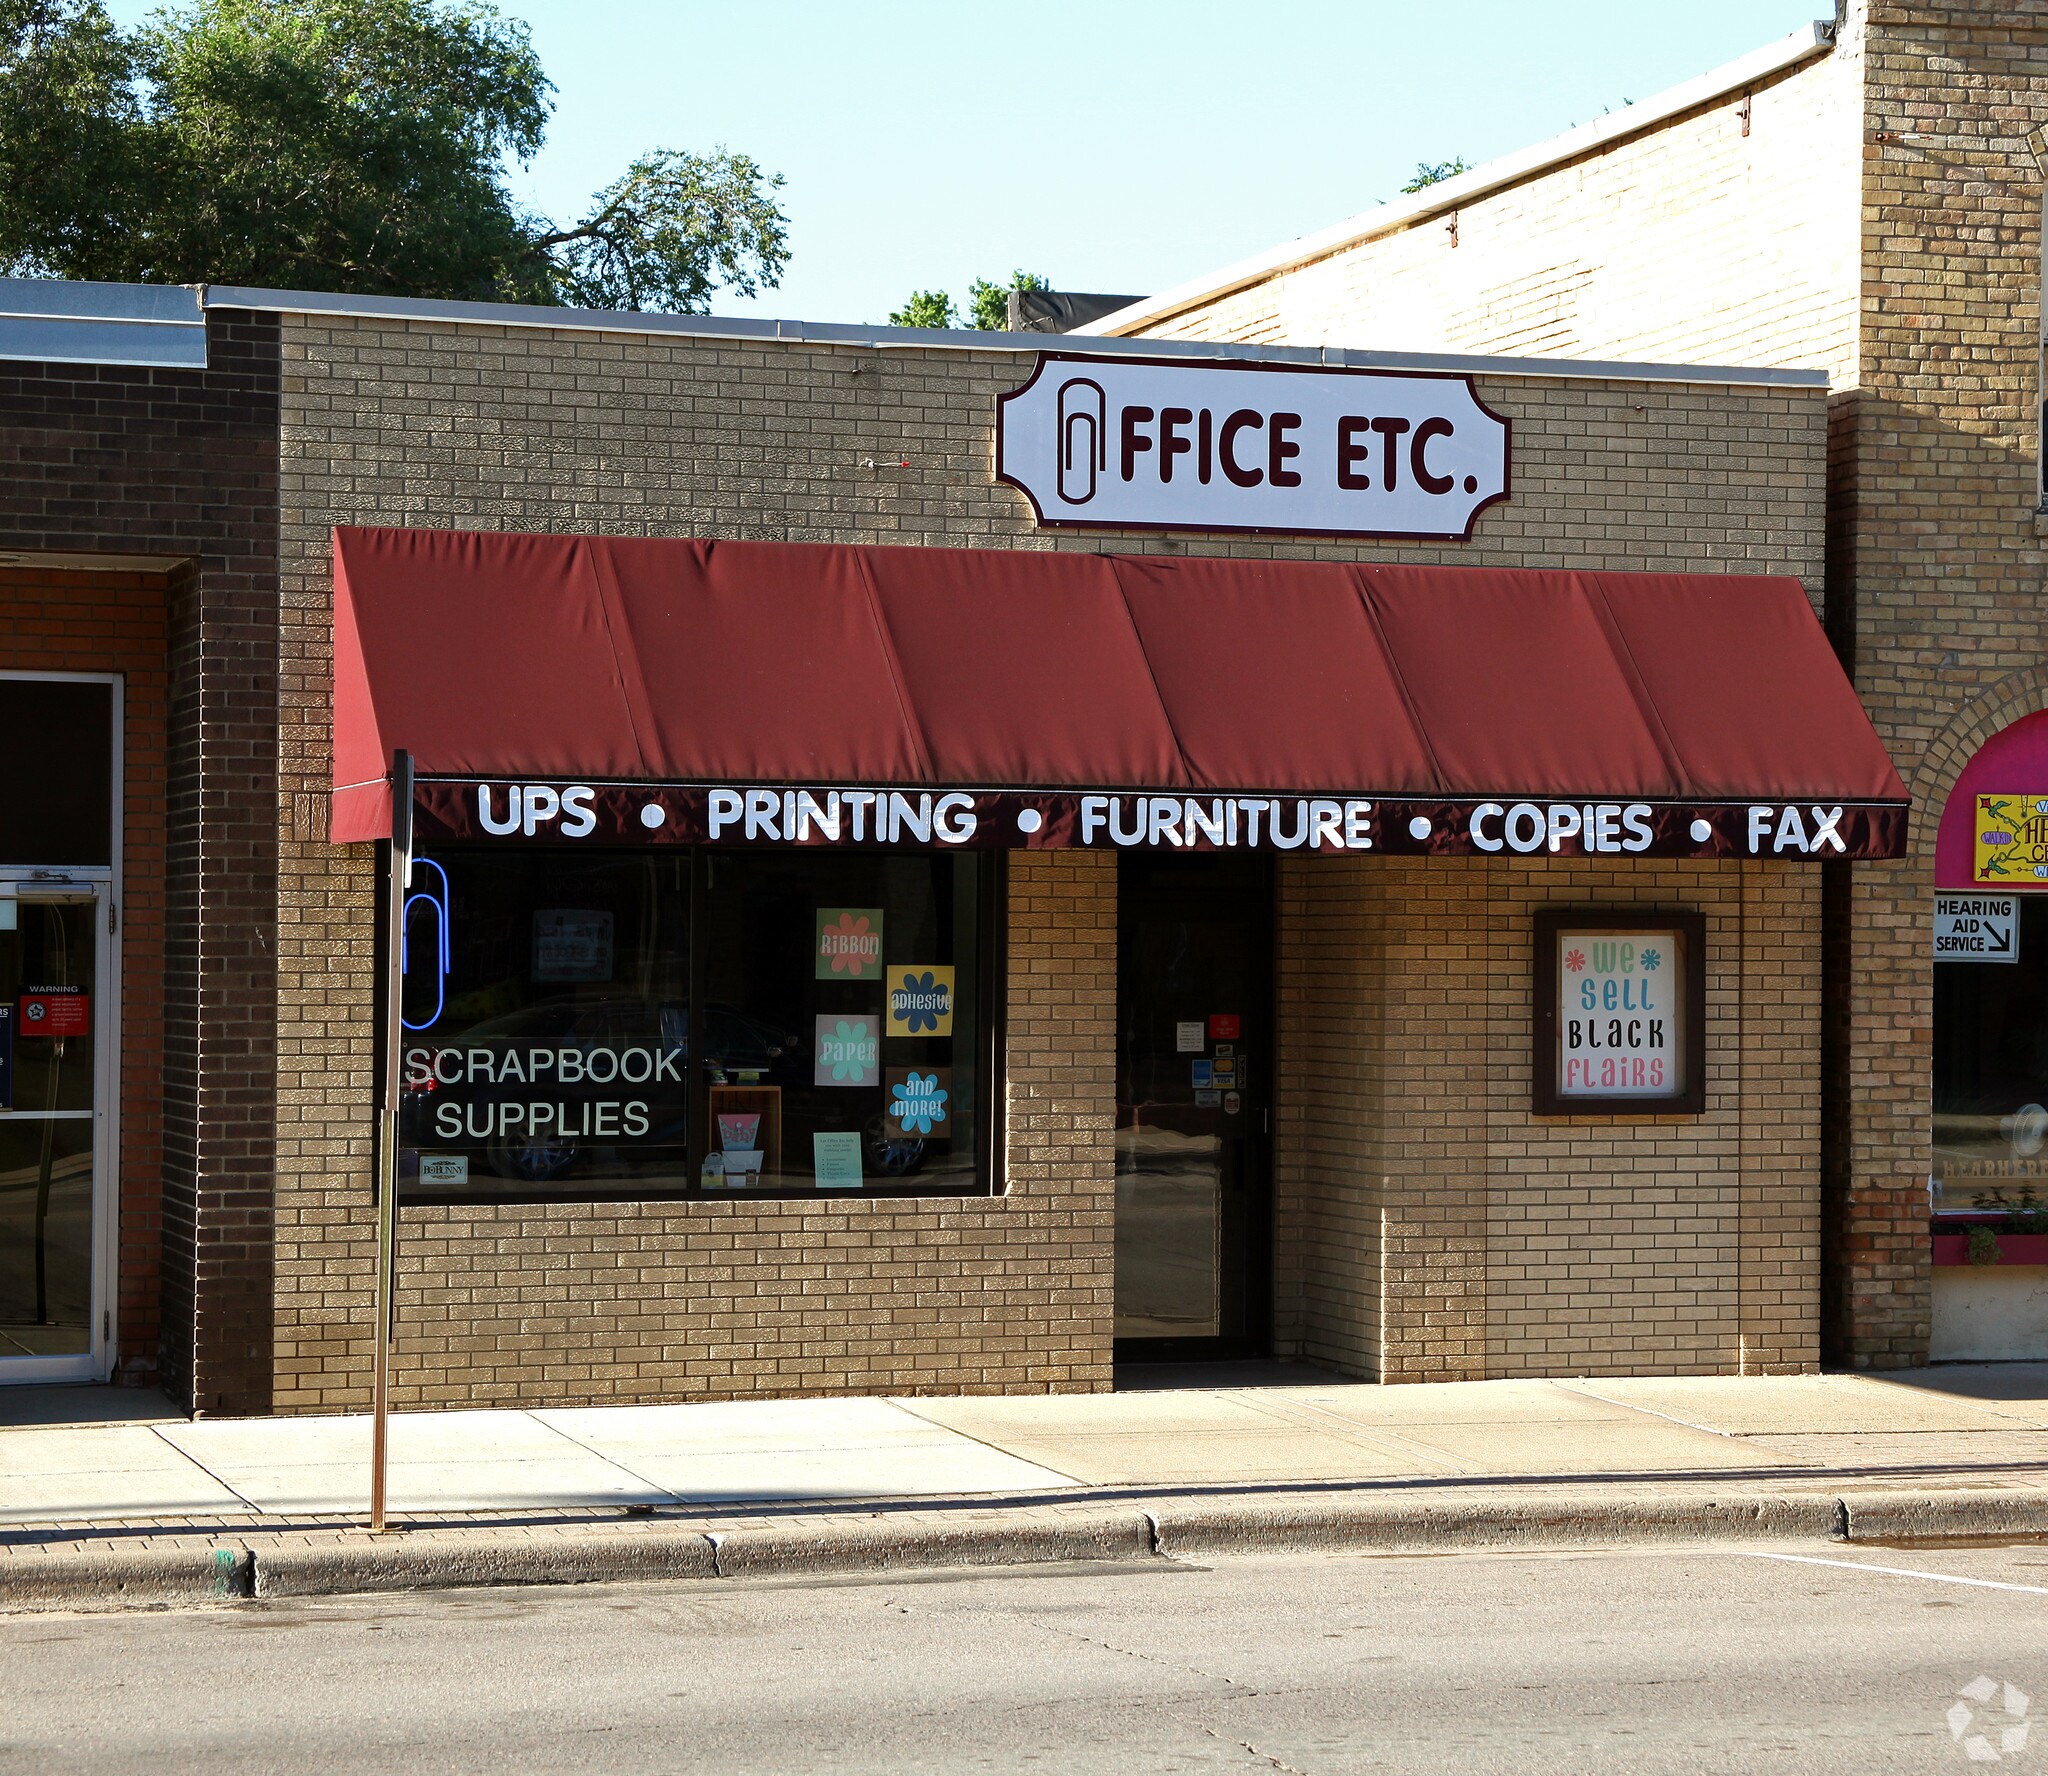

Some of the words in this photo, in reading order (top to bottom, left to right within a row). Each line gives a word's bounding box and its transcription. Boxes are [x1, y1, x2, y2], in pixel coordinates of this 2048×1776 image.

[1336, 414, 1479, 497] ETC.
[477, 784, 597, 838] UPS
[707, 788, 977, 844] PRINTING
[1080, 796, 1372, 850] FURNITURE
[1467, 802, 1653, 855] COPIES
[1747, 805, 1847, 855] FAX
[2036, 866, 2048, 877] W
[1937, 900, 2011, 917] HEARING
[1952, 919, 1980, 933] AID
[1936, 936, 1984, 952] SERVICE
[29, 985, 79, 993] WARNING
[404, 1047, 682, 1085] SCRAPBOOK
[435, 1101, 650, 1138] SUPPLIES
